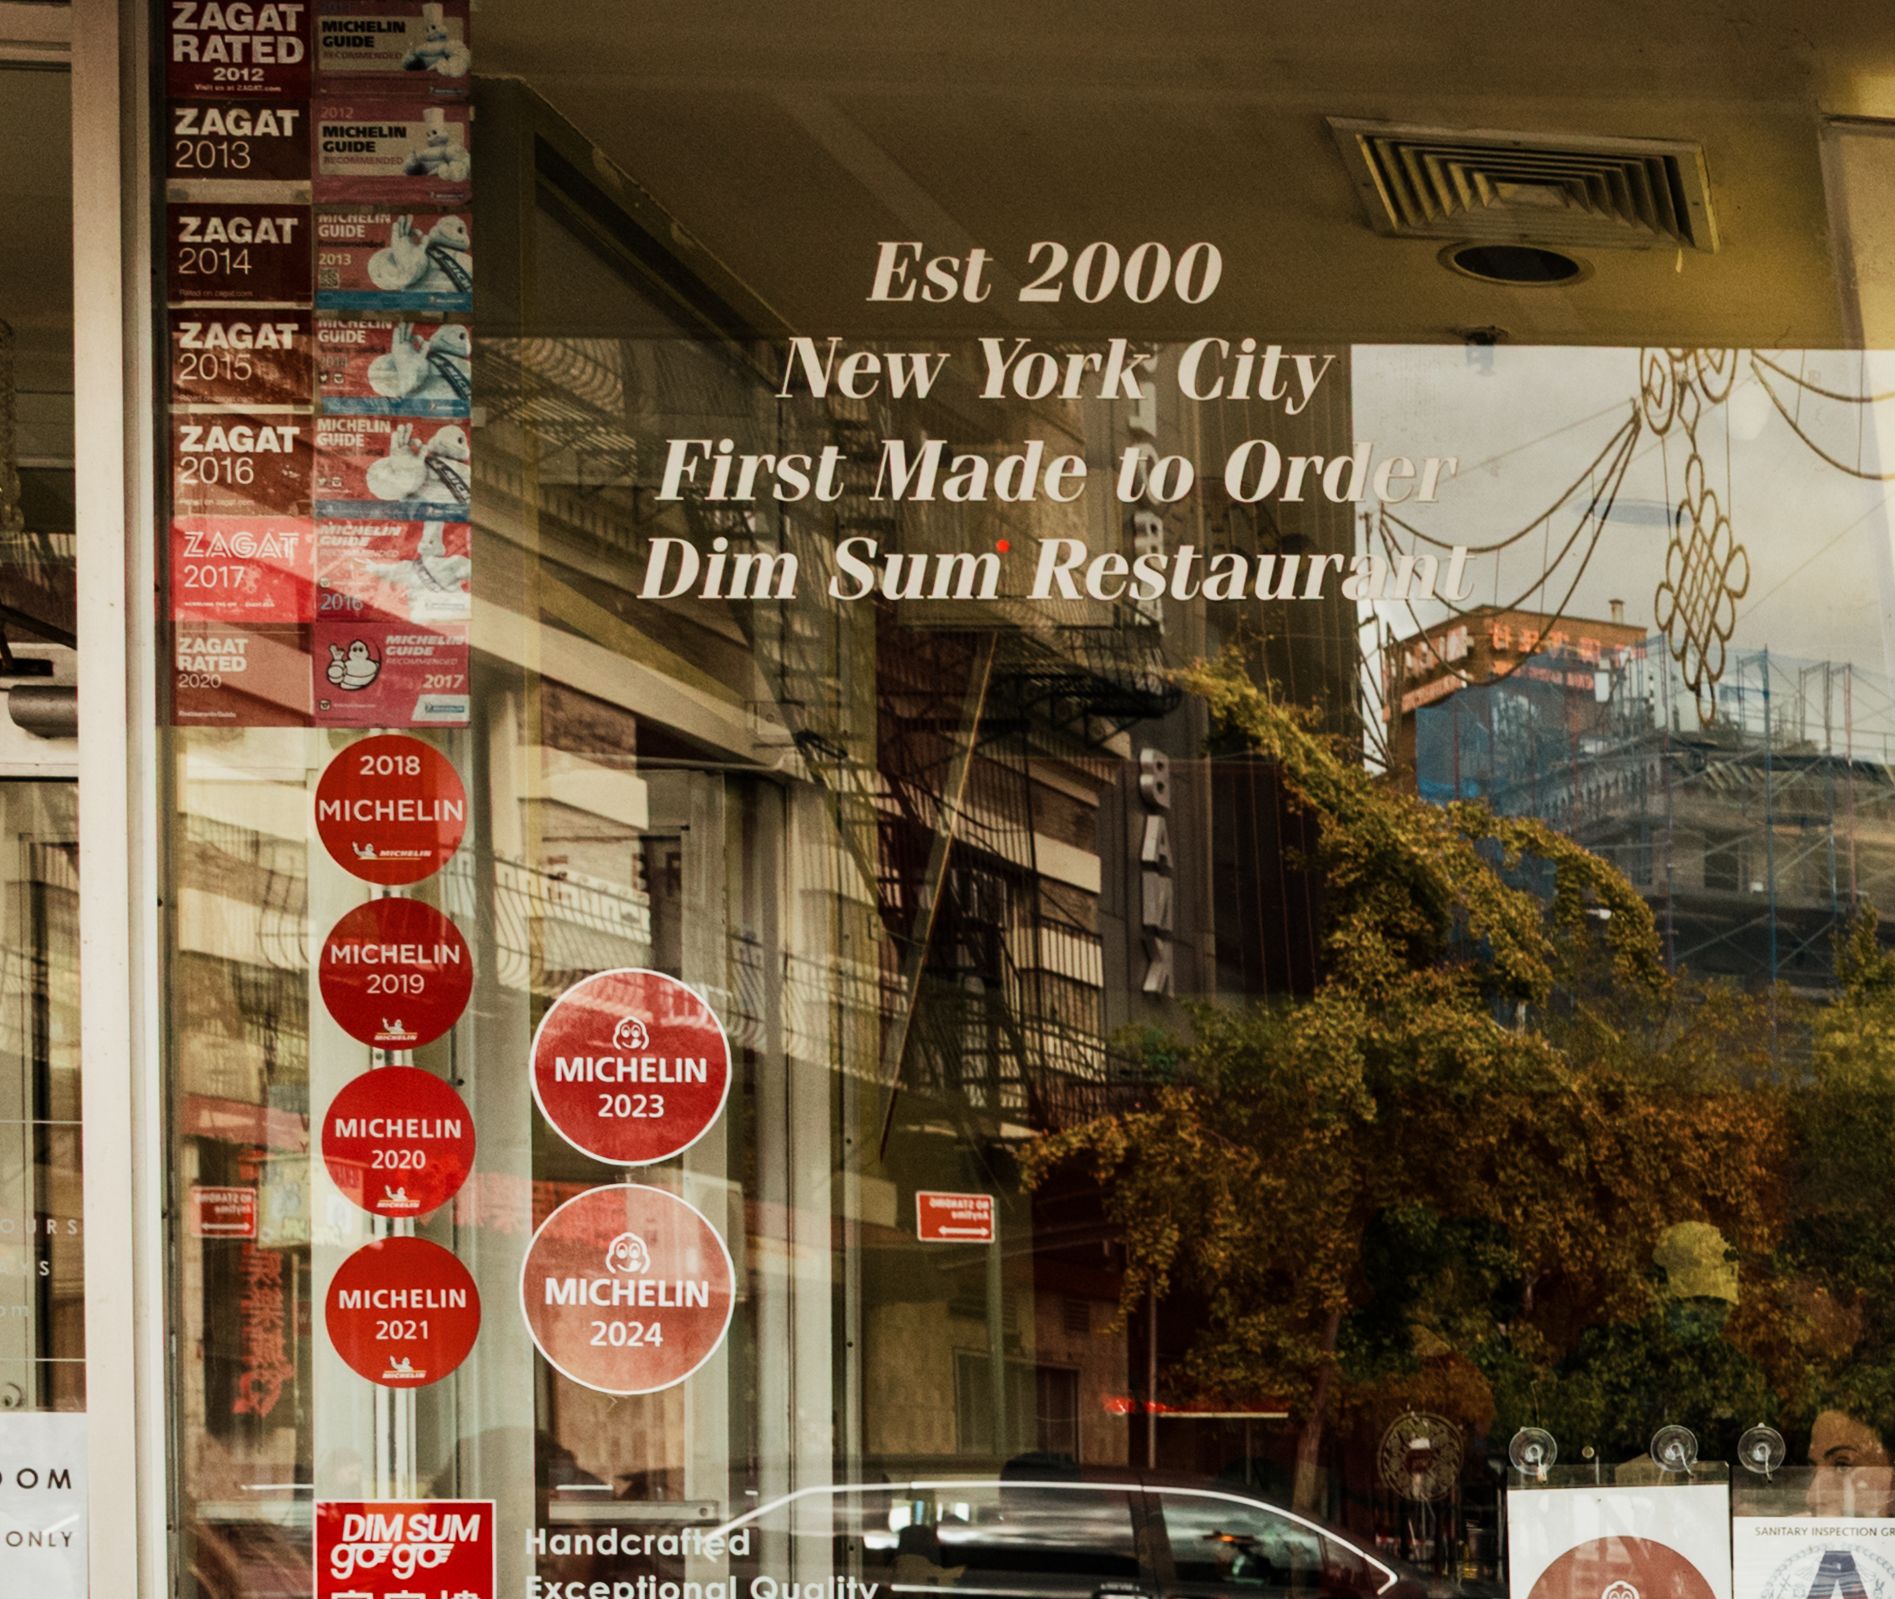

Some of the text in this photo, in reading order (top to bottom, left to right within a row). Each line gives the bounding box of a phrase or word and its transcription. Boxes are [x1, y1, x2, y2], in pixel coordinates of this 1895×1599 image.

[172, 2, 304, 31] ZAGAT
[322, 21, 406, 34] MICHELIN
[172, 35, 304, 64] RATED
[322, 36, 375, 48] GUIDE
[213, 68, 265, 82] 2012
[174, 108, 300, 137] ZAGAT
[320, 107, 354, 119] 2012
[322, 126, 407, 138] MICHELIN
[175, 140, 251, 169] 2013
[322, 140, 376, 153] GUIDE
[323, 156, 404, 165] RECOMMENDED
[178, 217, 298, 244] ZAGAT
[318, 225, 365, 238] GUIDE
[178, 248, 252, 275] 2014
[318, 254, 351, 266] 2013
[866, 241, 1224, 304] Est 2000
[178, 322, 299, 350] ZAGAT
[318, 330, 366, 344] GUIDE
[179, 353, 252, 381] 2015
[776, 336, 1336, 414] New York City
[317, 418, 392, 433] MICHELIN
[180, 426, 300, 453] ZAGAT
[317, 434, 365, 448] GUIDE
[180, 457, 254, 485] 2016
[654, 438, 1460, 503] First Made to Order
[320, 525, 401, 537] MICHELIN
[184, 531, 299, 559] ZAGAT
[319, 537, 370, 547] GUIDE
[184, 565, 245, 588] 2017
[636, 537, 1477, 601] Dim Sum Restaurant
[320, 594, 364, 611] 2016
[178, 638, 249, 654] ZAGAT
[386, 635, 466, 645] MICHELIN
[386, 646, 434, 656] GUIDE
[178, 655, 247, 672] RATED
[178, 674, 222, 689] 2020
[423, 674, 464, 689] 2017
[360, 755, 421, 776] 2018
[318, 799, 464, 822] MICHELIN
[379, 849, 432, 858] MICHELIN
[330, 944, 460, 965] MICHELIN
[366, 974, 425, 994] 2019
[554, 1056, 708, 1084] MICHELIN
[597, 1093, 665, 1119] 2023
[335, 1118, 462, 1138] MICHELIN
[371, 1150, 426, 1170] 2020
[338, 1289, 467, 1309] MICHELIN
[544, 1277, 710, 1308] MICHELIN
[375, 1320, 429, 1340] 2021
[589, 1320, 664, 1347] 2024
[0, 1469, 72, 1490] OM
[342, 1513, 481, 1542] DIM SUM
[1755, 1527, 1809, 1537] SANITARY
[1811, 1527, 1877, 1537] INSPECTION
[5, 1531, 74, 1549] ONLY
[525, 1528, 750, 1556] Handcrafted
